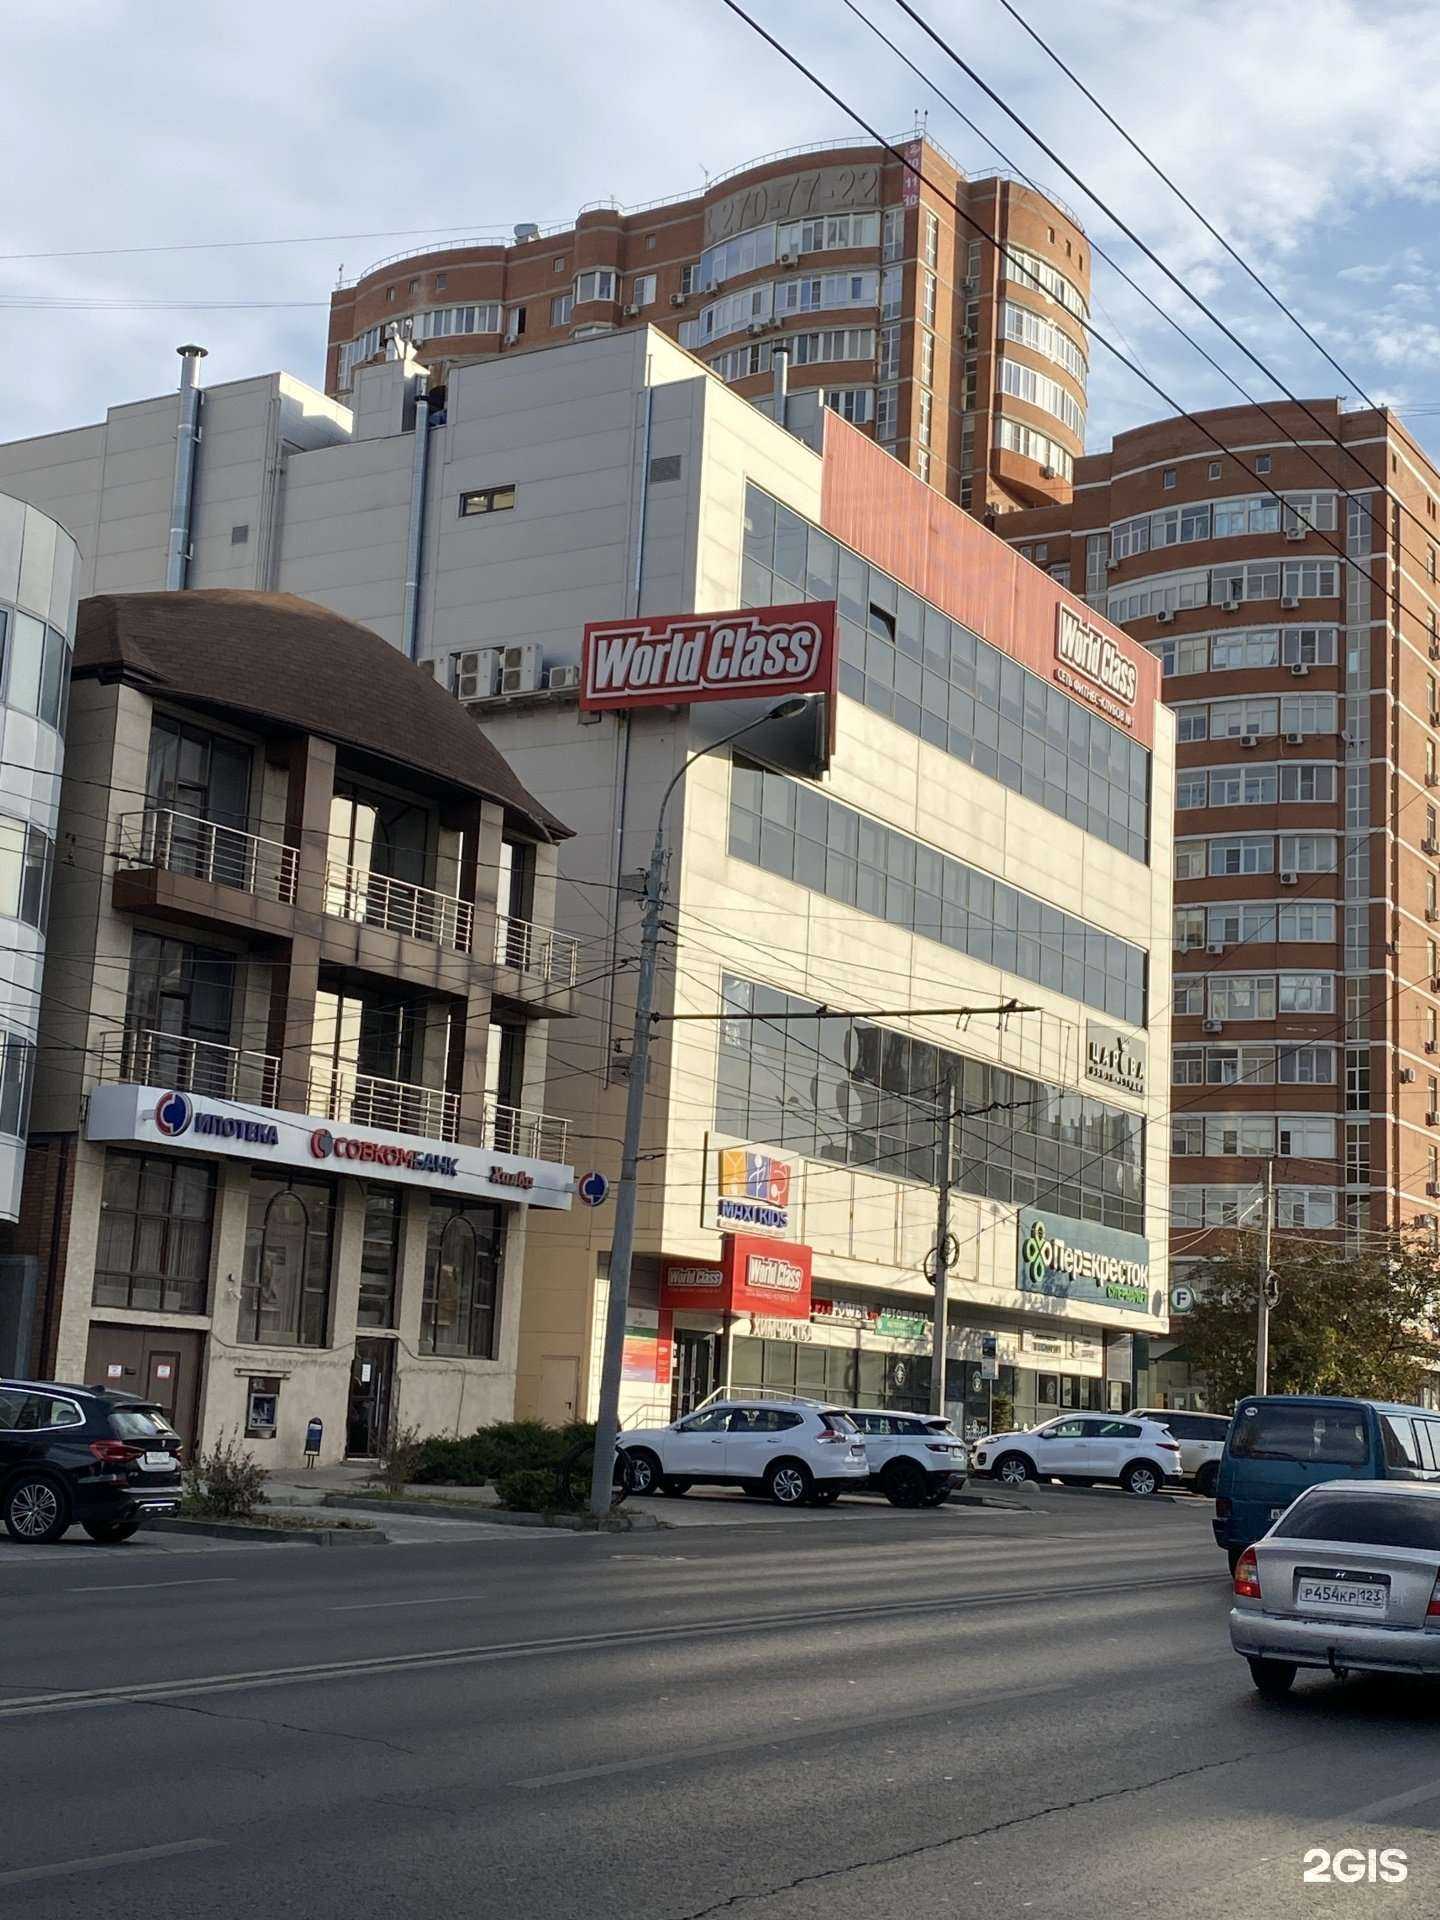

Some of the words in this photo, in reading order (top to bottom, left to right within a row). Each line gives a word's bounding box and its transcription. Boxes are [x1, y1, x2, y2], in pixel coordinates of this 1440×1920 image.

[595, 629, 705, 689] World
[707, 627, 811, 681] Class
[1060, 609, 1103, 678] World
[1101, 642, 1136, 701] Class
[194, 1112, 279, 1146] ИПОТЕКА
[333, 1137, 459, 1177] СОВКОМБАНК
[718, 1199, 759, 1223] MAXI
[759, 1207, 788, 1228] KIDS
[670, 1270, 695, 1285] World
[696, 1272, 721, 1285] Class
[749, 1257, 776, 1287] World
[776, 1261, 801, 1291] Class
[751, 1315, 813, 1341] ХИМЧИСТКА
